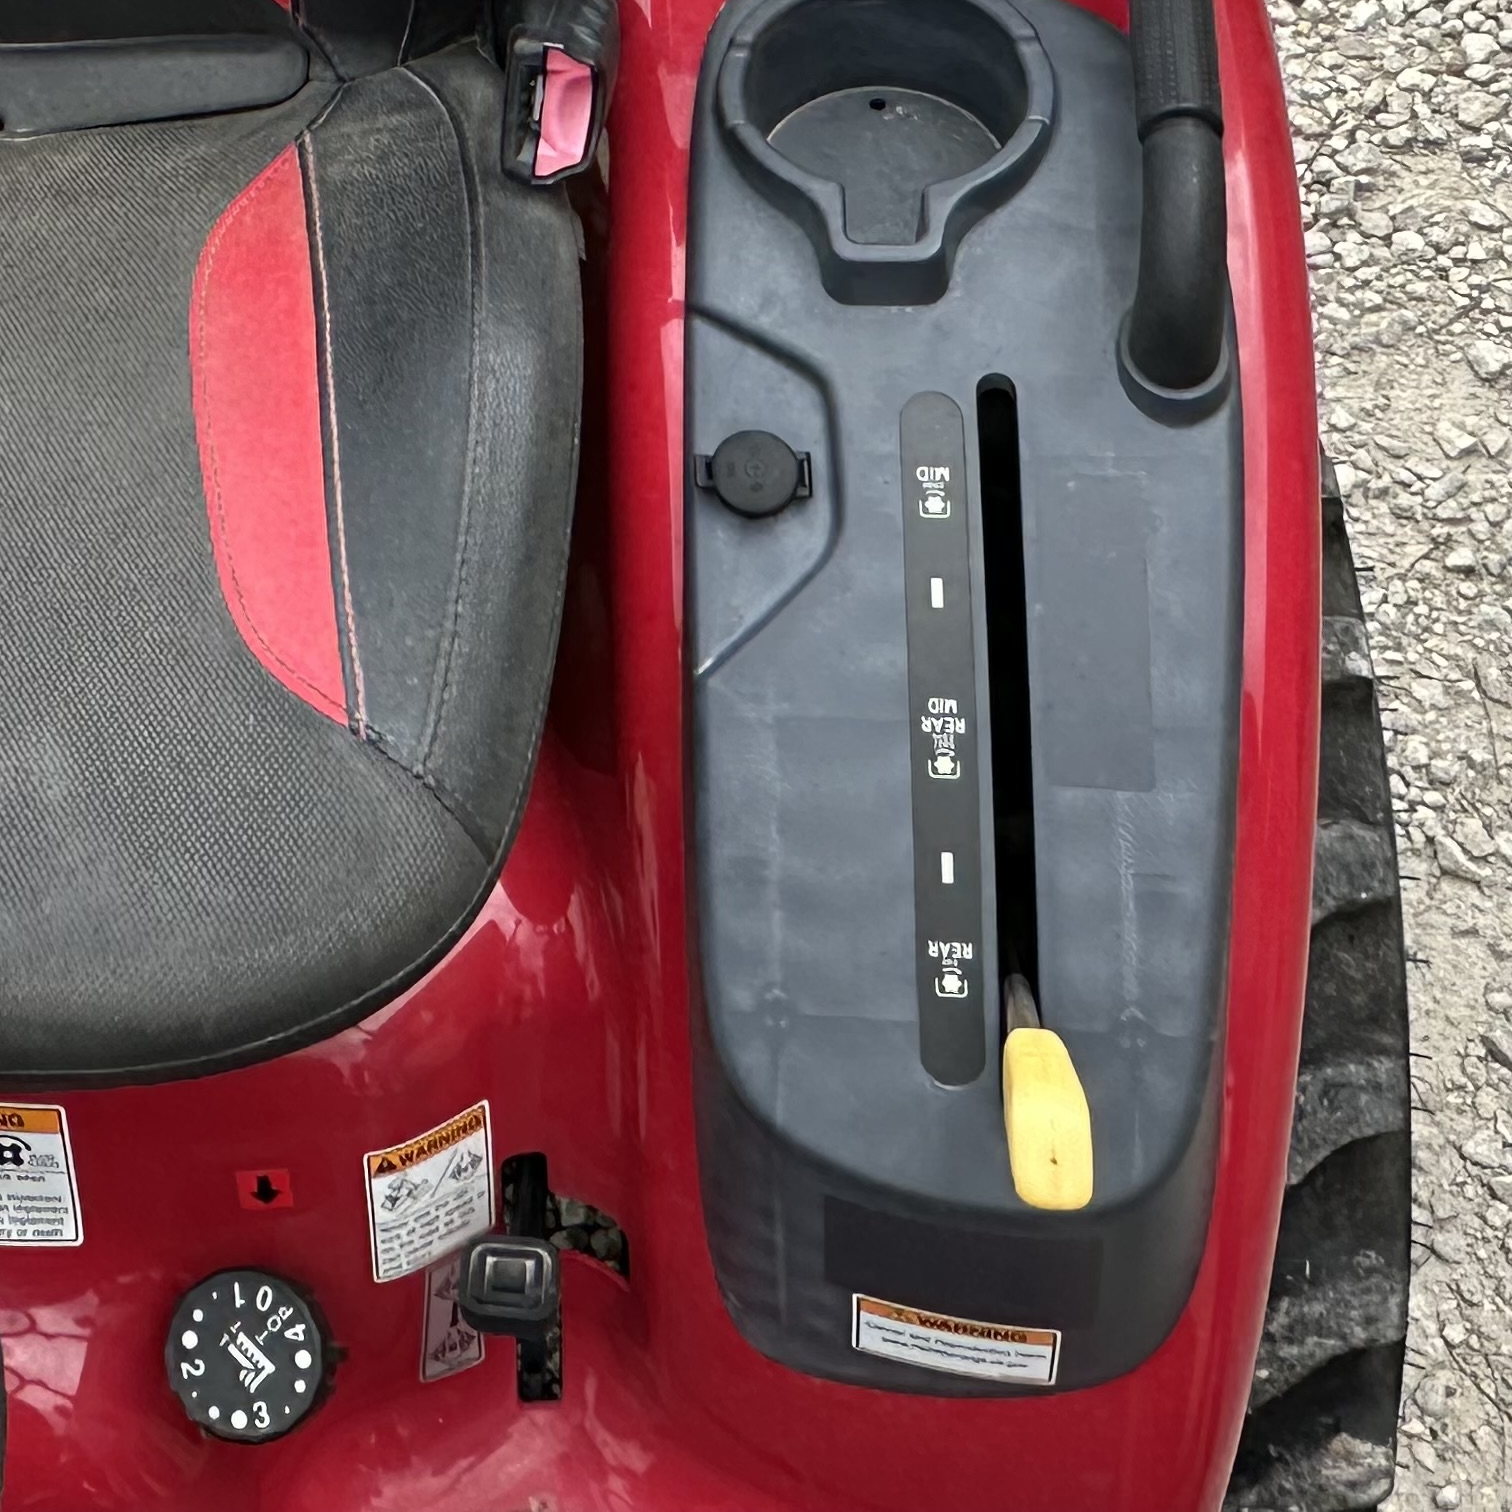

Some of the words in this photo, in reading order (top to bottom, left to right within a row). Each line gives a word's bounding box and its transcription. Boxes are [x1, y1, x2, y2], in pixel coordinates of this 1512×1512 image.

[916, 466, 950, 482] MID
[928, 697, 958, 714] MID
[920, 715, 966, 734] REAR
[927, 939, 973, 960] REAR
[399, 1114, 483, 1166] WARNING
[255, 1285, 273, 1312] 0
[180, 1358, 206, 1380] 2
[252, 1400, 271, 1429] 3
